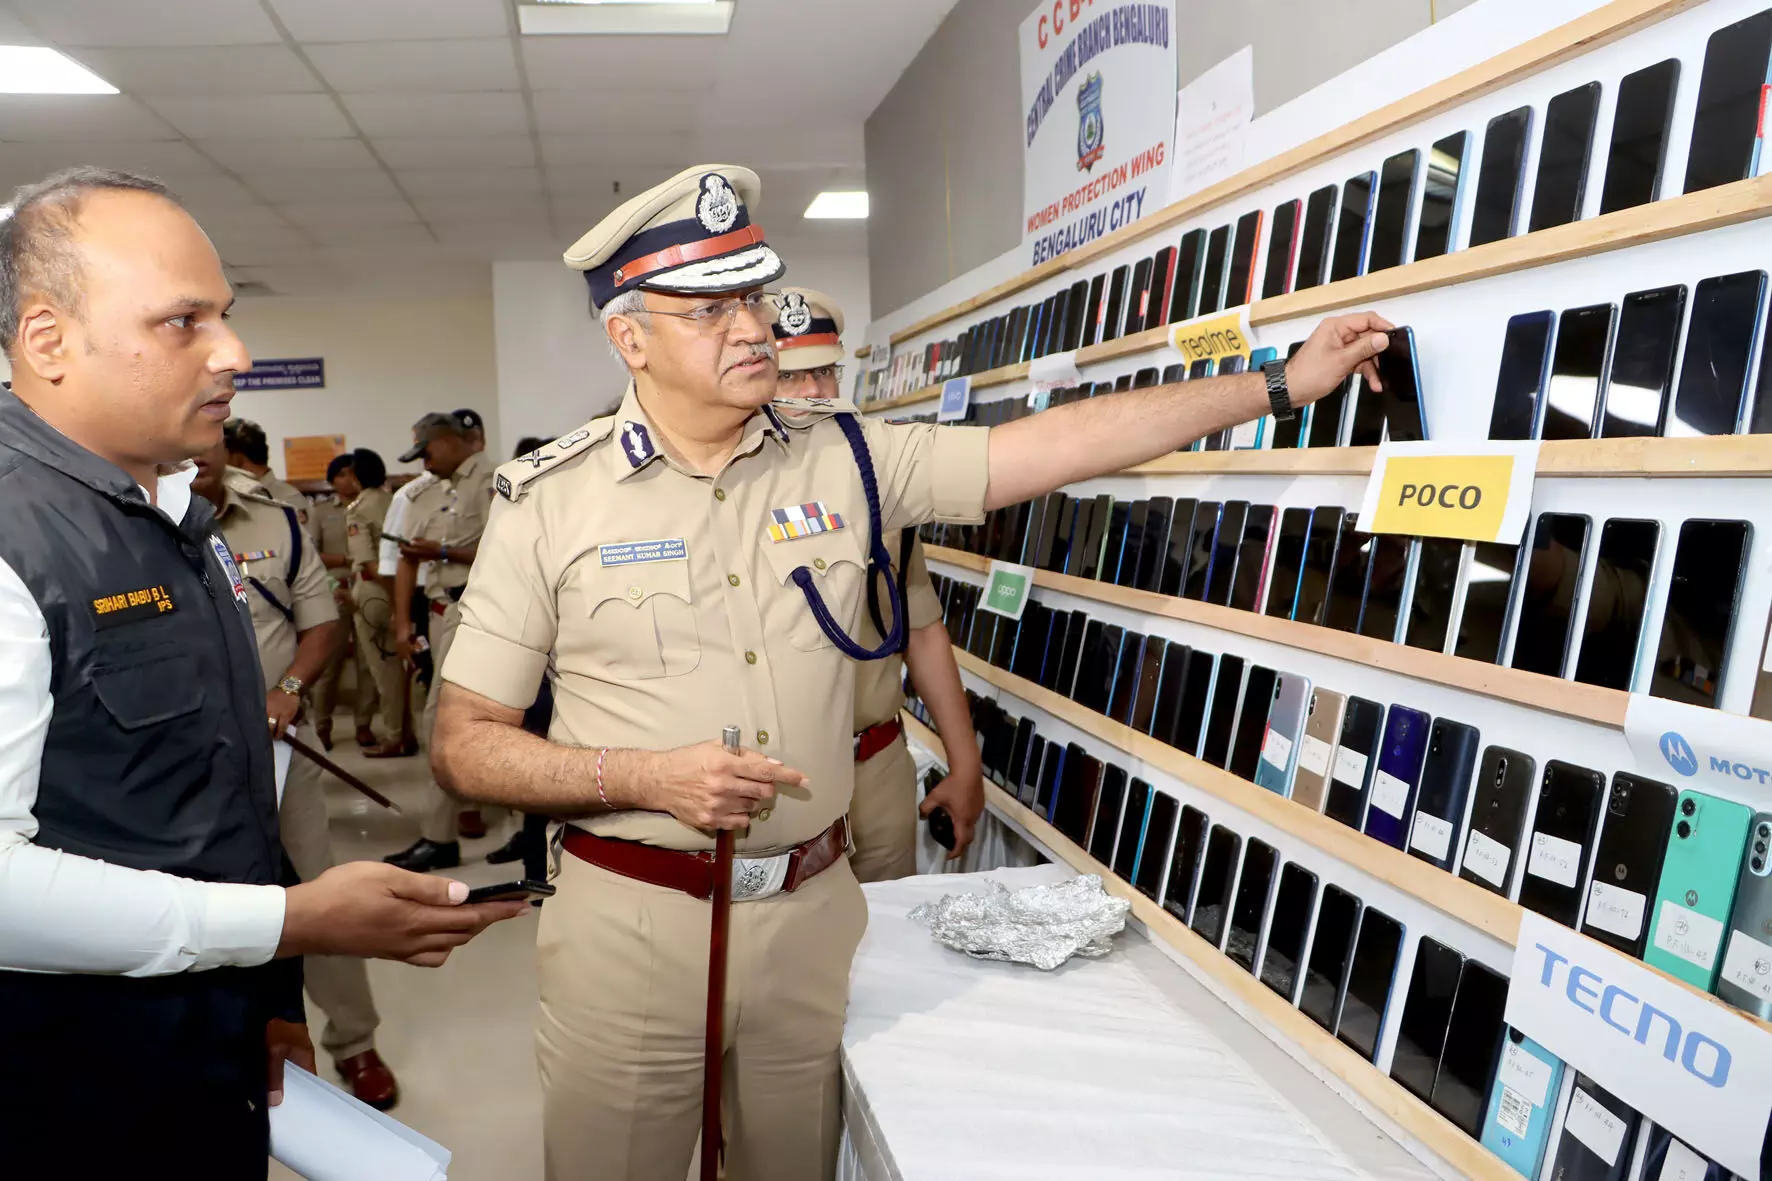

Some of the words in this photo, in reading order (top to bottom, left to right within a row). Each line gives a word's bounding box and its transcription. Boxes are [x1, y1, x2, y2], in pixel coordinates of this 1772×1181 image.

[1054, 38, 1077, 96] CRIME
[1077, 11, 1111, 68] BRANCH
[1112, 4, 1169, 49] BENGALURU
[1027, 201, 1060, 233] WOMEN
[1061, 166, 1128, 217] PROTECTION
[1131, 141, 1165, 180] WING
[1032, 206, 1107, 267] BENGALURU
[1109, 186, 1147, 232] CITY
[1181, 328, 1241, 359] realme
[1398, 484, 1482, 510] POCO
[603, 554, 634, 563] SEEMANT
[636, 551, 661, 560] KUMAR
[662, 549, 684, 557] SINGH
[93, 594, 128, 614] SRIHARI
[127, 588, 152, 607] BABU
[151, 587, 160, 601] B
[159, 585, 169, 599] L
[157, 599, 173, 612] IPS
[1709, 756, 1772, 785] MOT
[1535, 943, 1732, 1089] TECNO
